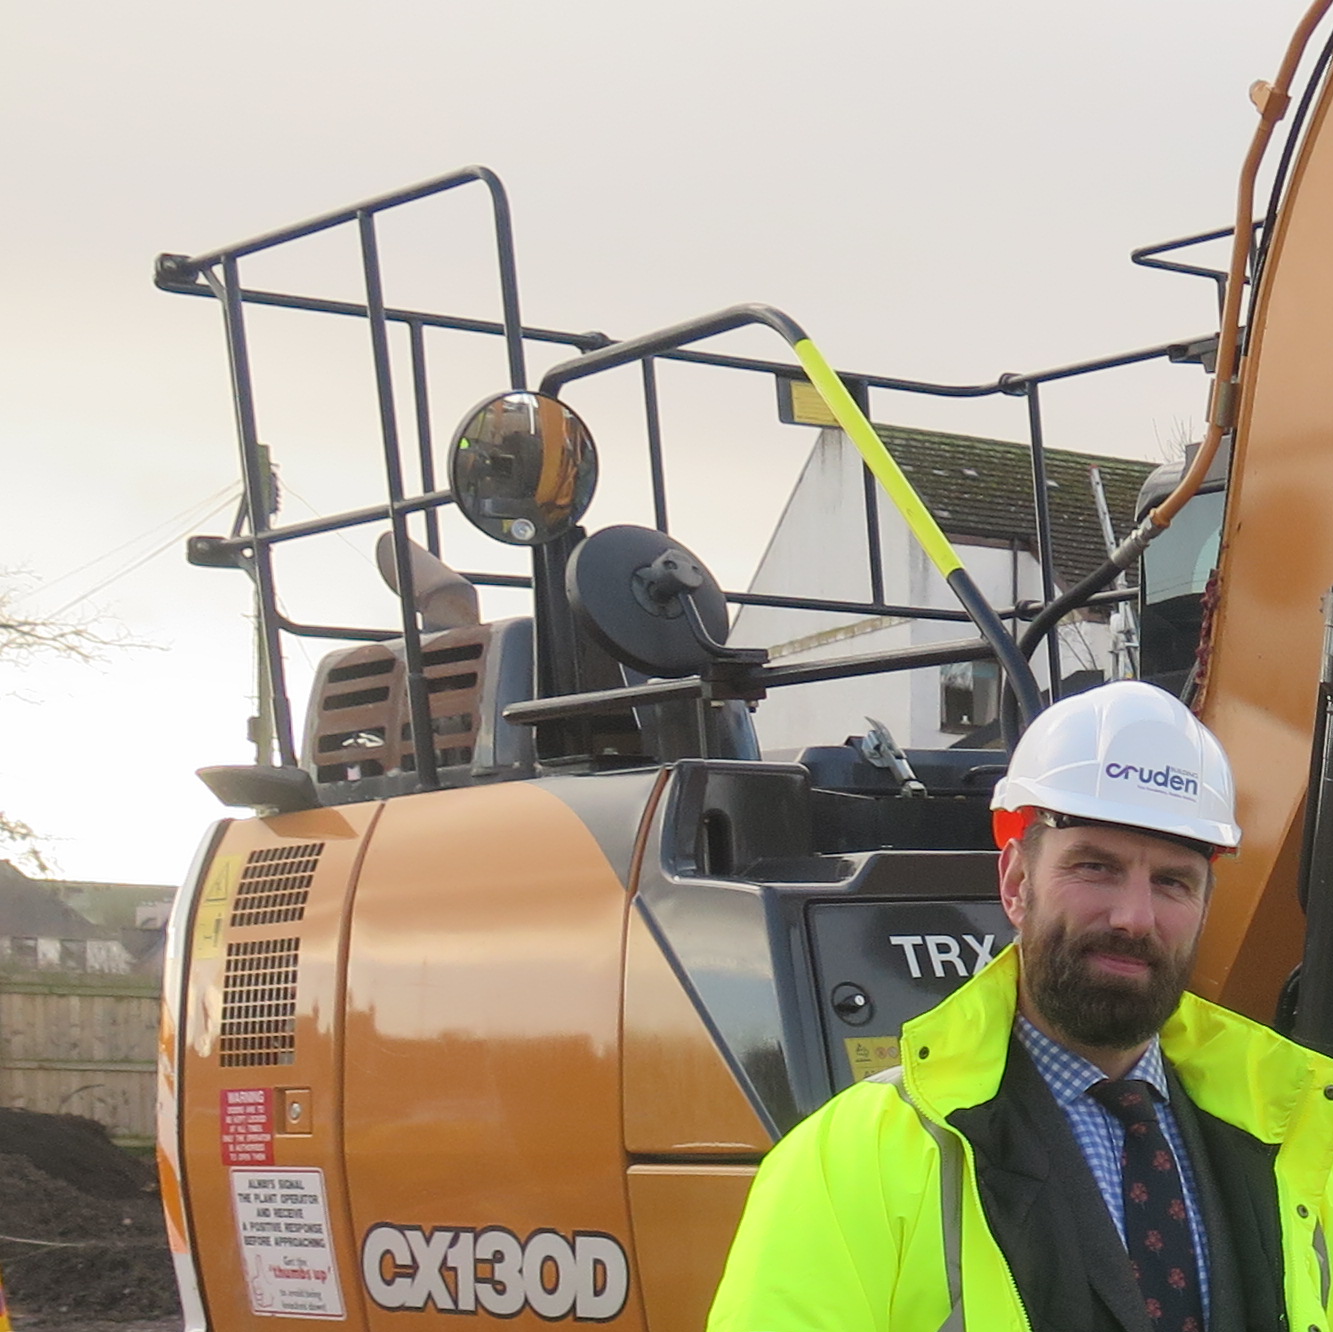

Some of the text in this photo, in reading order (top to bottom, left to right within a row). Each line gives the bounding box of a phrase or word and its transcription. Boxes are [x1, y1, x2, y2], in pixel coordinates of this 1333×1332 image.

[1105, 763, 1198, 795] cruden
[889, 933, 995, 977] TRX
[226, 1090, 265, 1104] WARNING
[248, 1179, 305, 1190] ALWAYS SIGNAL
[237, 1193, 319, 1204] THE PLANT OPERATOR
[256, 1208, 304, 1219] AND RECEIVE
[242, 1222, 323, 1234] A POSITIVE RESPONSE
[244, 1236, 326, 1248] BEFORE APPROACHING
[283, 1255, 295, 1266] Get
[361, 1222, 630, 1324] CX130D
